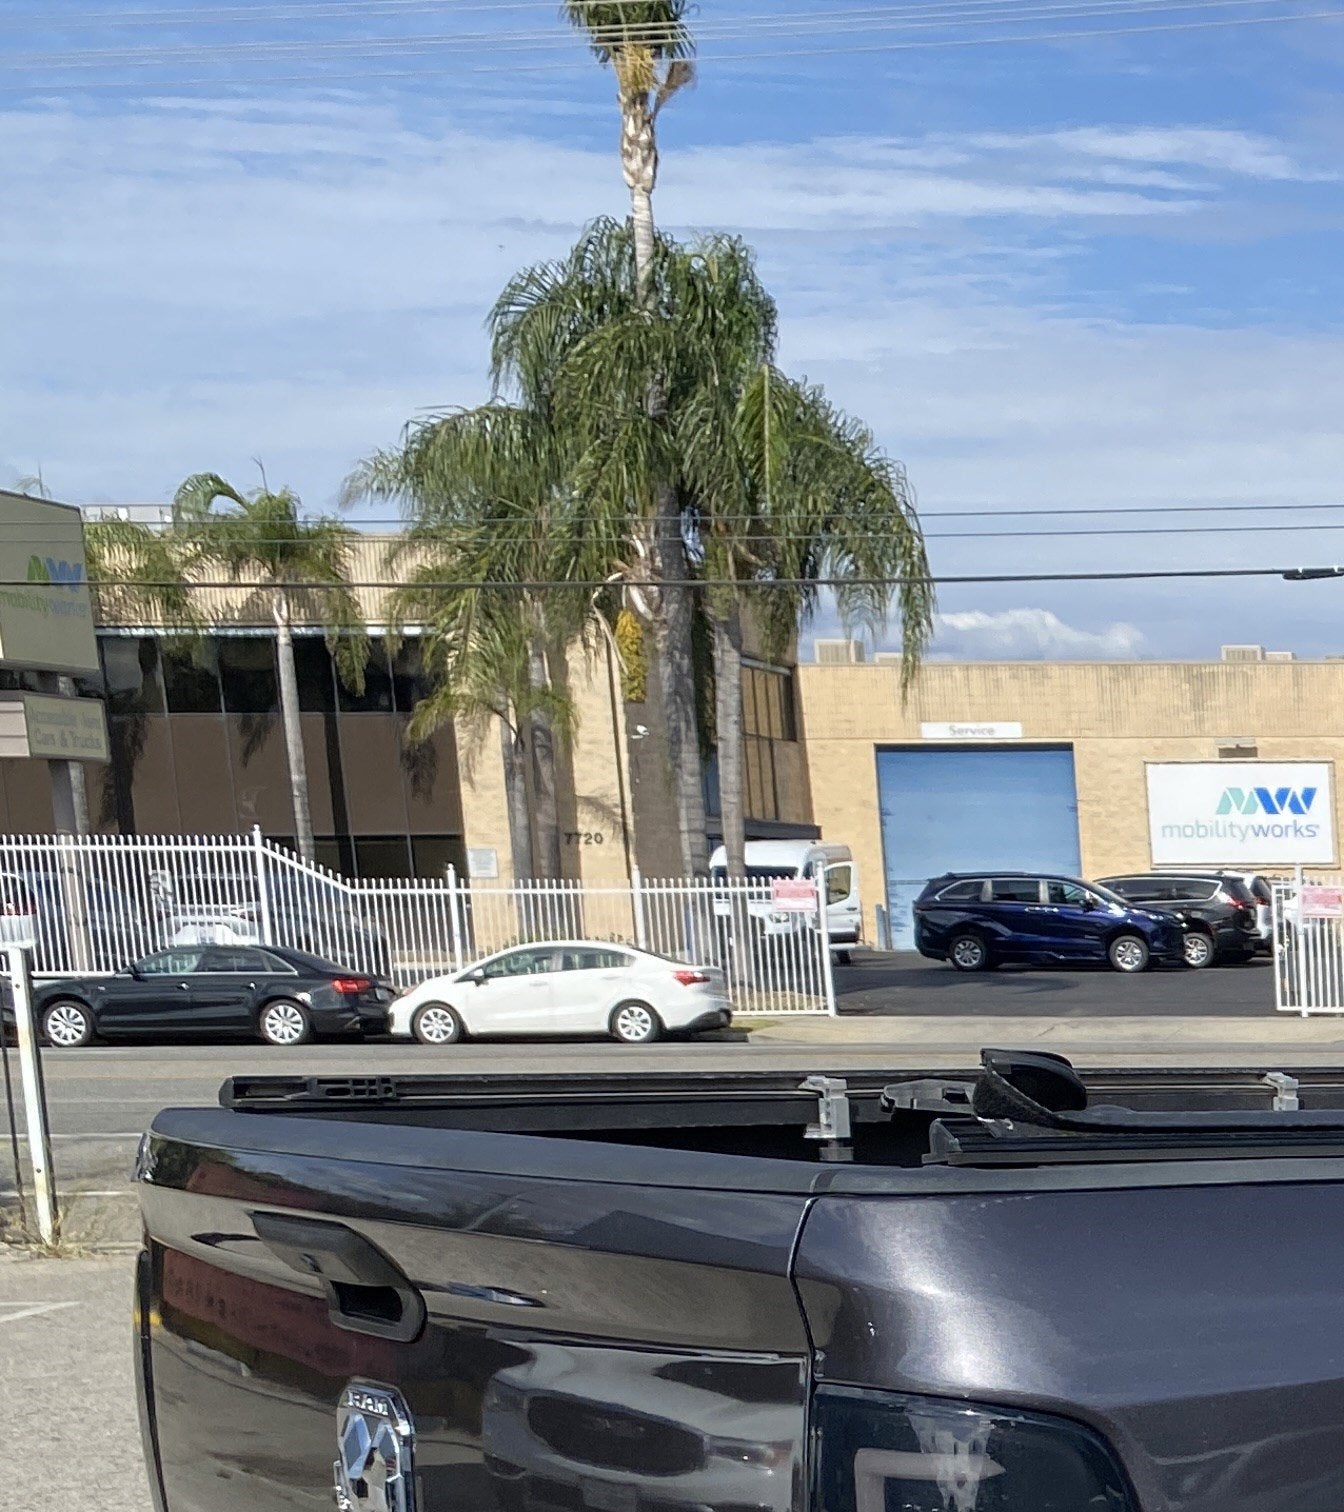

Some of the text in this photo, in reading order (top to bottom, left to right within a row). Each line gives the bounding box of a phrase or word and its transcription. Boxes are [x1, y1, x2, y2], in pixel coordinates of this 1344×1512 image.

[949, 724, 995, 736] Service
[564, 832, 604, 845] 7720
[1161, 820, 1318, 843] mobilityworks
[346, 1389, 389, 1416] RAM
